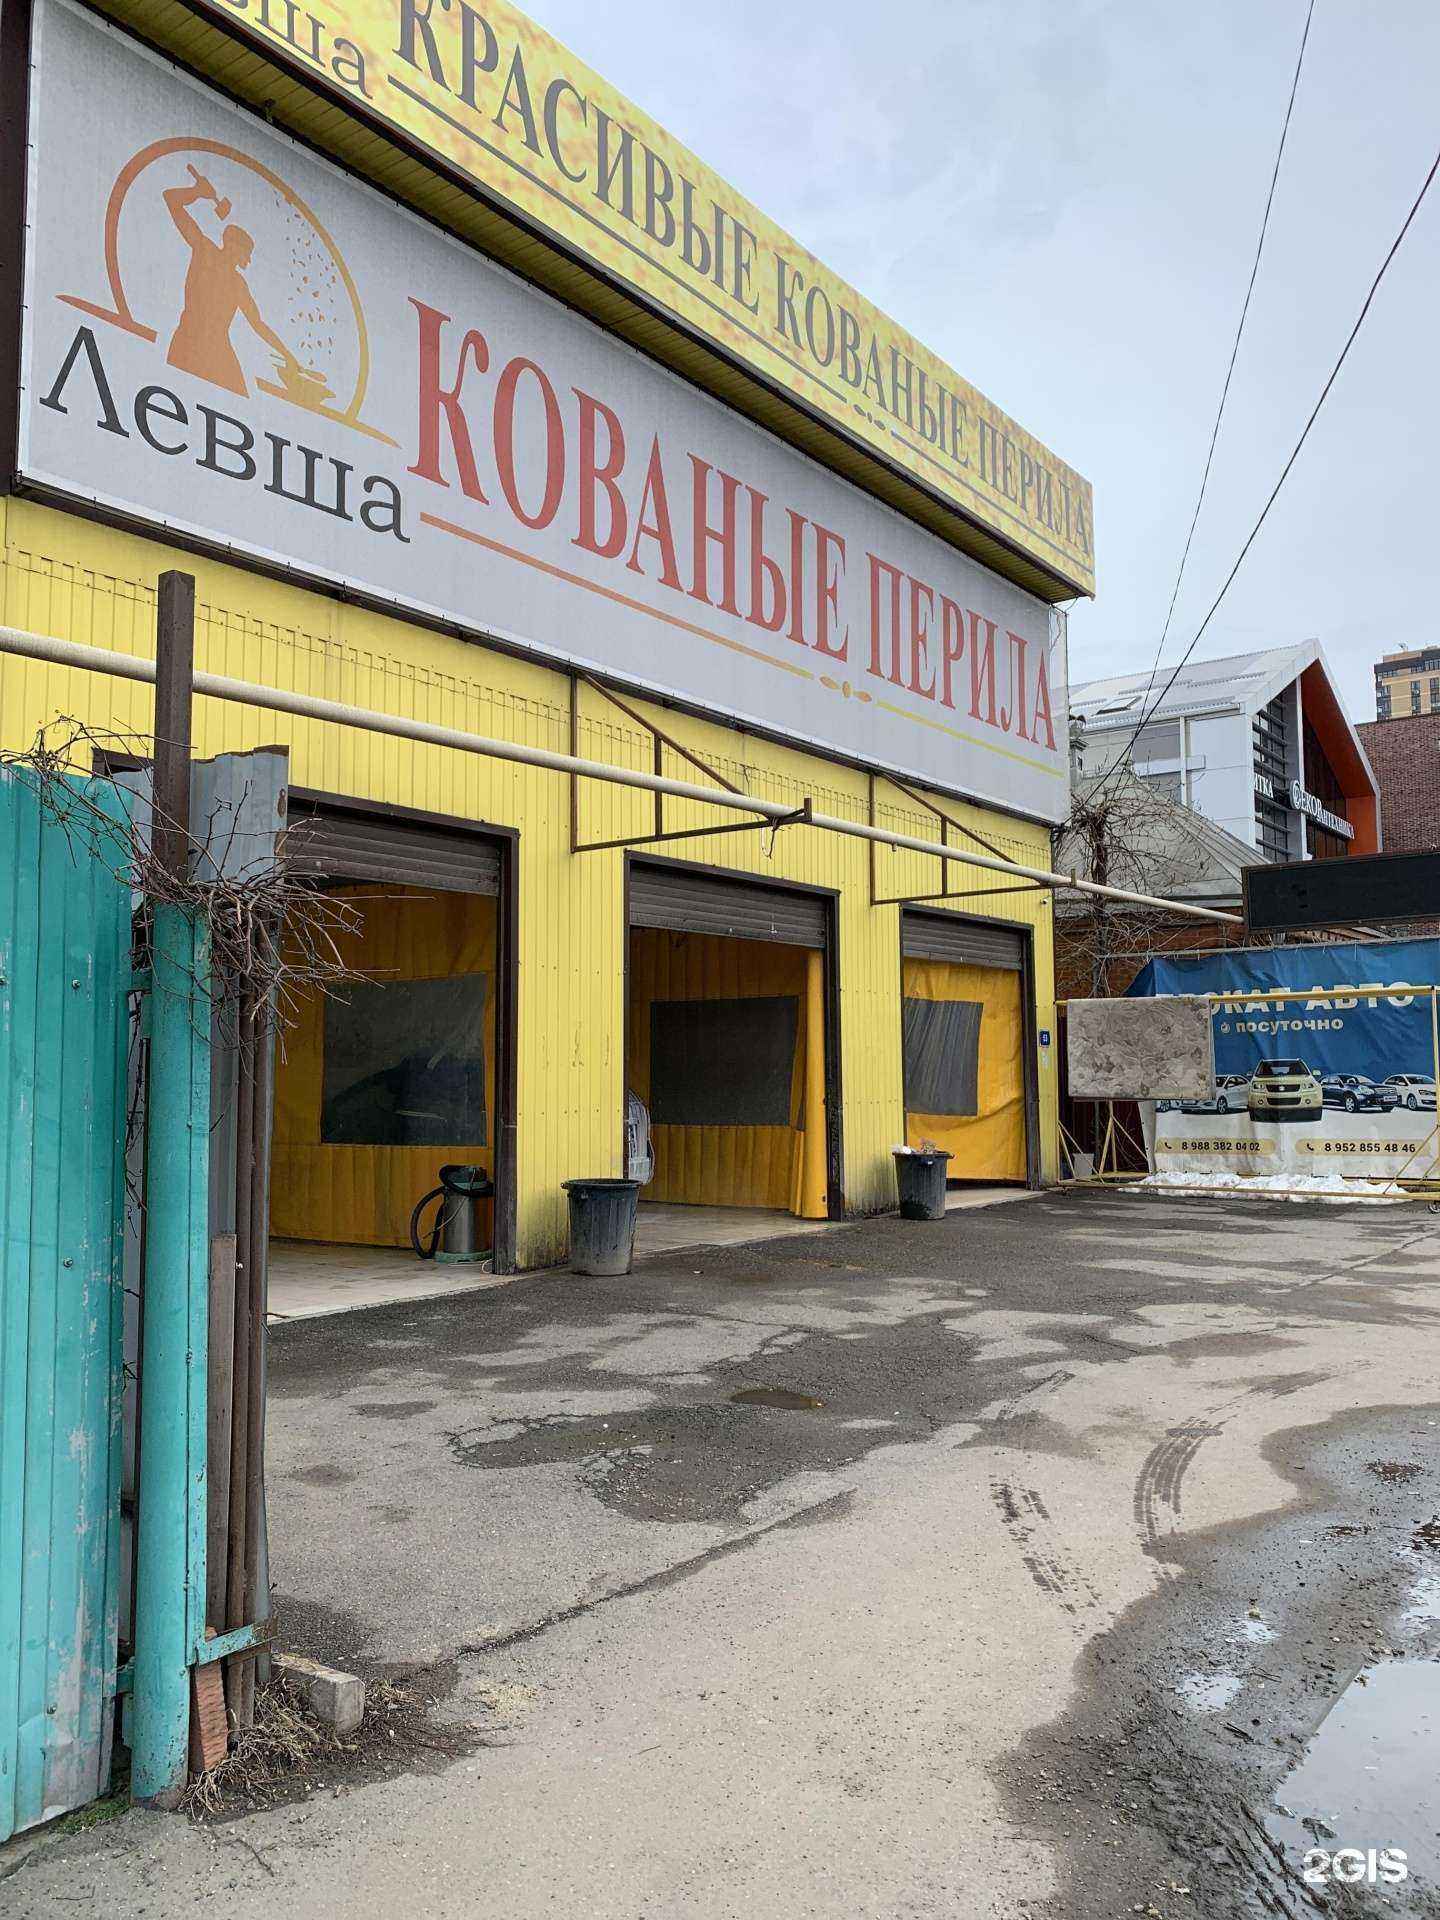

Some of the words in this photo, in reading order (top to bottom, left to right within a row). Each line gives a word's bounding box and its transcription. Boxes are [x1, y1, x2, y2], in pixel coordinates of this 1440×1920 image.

[392, 0, 760, 316] КРАСИВЫЕ
[773, 252, 970, 469] КОВАНЫЕ
[978, 416, 1093, 555] ПЕРИЛА
[39, 324, 411, 544] Левша
[406, 295, 849, 663] КОВАНЫЕ
[866, 551, 1059, 752] ПЕРИЛА
[1304, 981, 1415, 1011] АВТО
[1236, 1018, 1344, 1036] посуточно
[1181, 1142, 1189, 1151] 8
[1213, 1142, 1233, 1151] 382
[1235, 1142, 1247, 1151] 04
[1249, 1142, 1261, 1152] 02
[1324, 1143, 1332, 1152] 8
[1334, 1143, 1356, 1152] 952
[1359, 1143, 1381, 1153] 855
[1384, 1143, 1398, 1153] 48
[1401, 1143, 1416, 1153] 46
